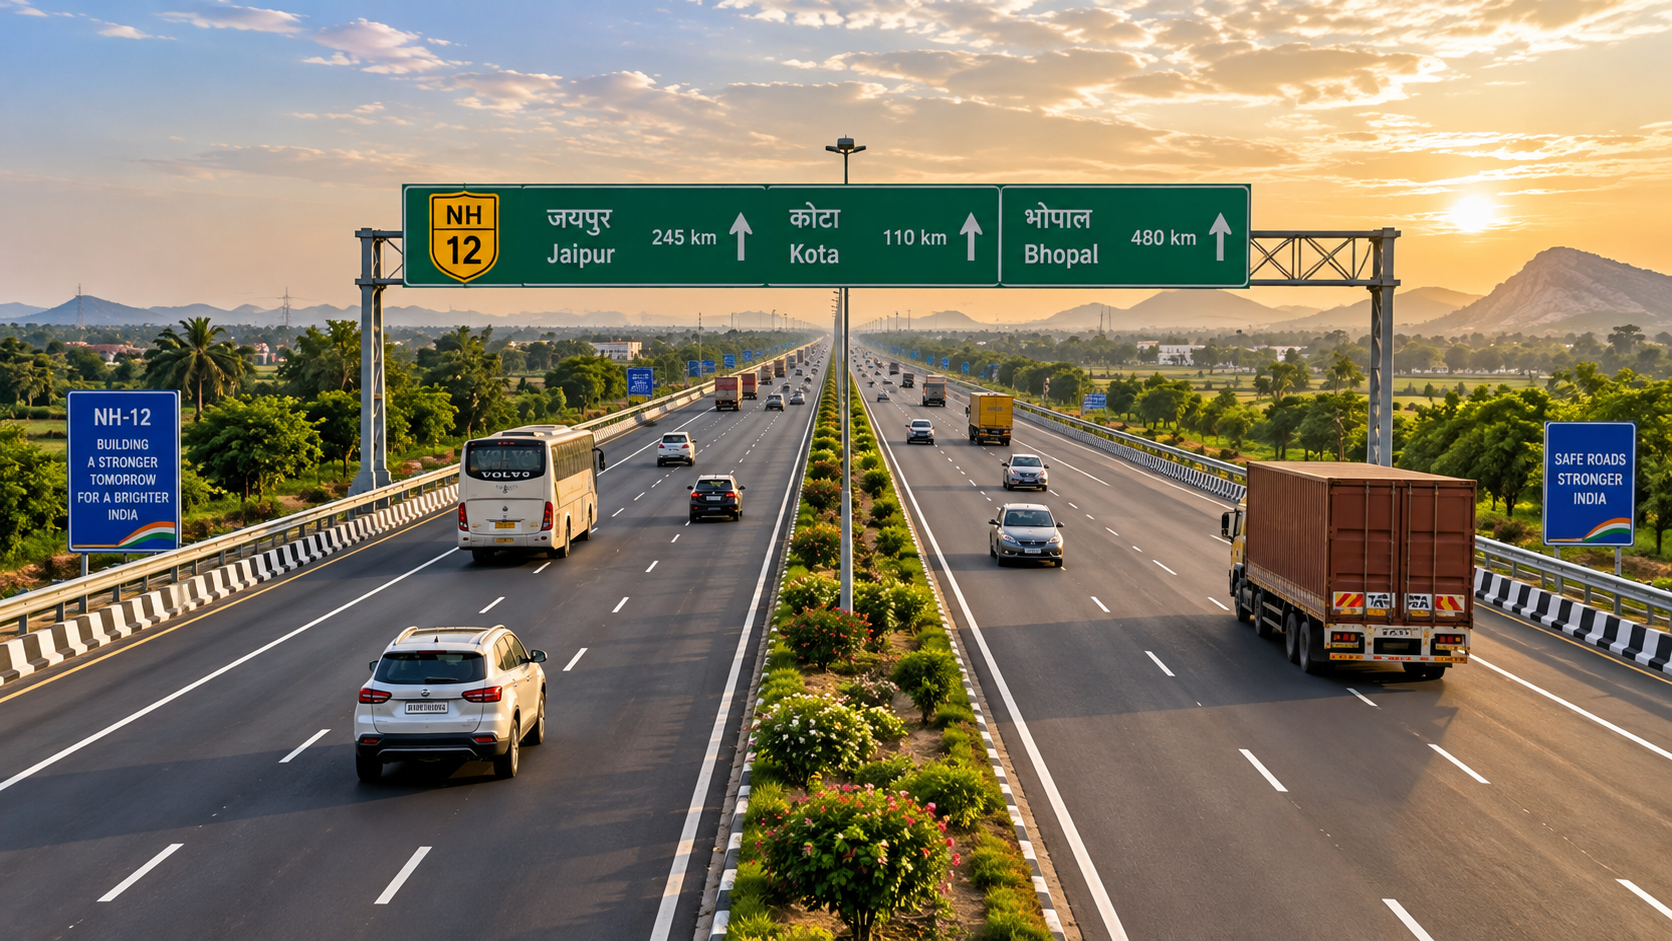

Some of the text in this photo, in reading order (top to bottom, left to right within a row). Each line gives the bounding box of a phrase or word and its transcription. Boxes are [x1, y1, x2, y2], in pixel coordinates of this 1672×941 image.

[446, 205, 482, 225] NH
[547, 208, 613, 235] जयपुर
[789, 202, 841, 229] कोटा
[1024, 202, 1093, 229] भोपाल
[652, 229, 717, 246] 245 km
[883, 229, 947, 246] 110 km
[1131, 229, 1197, 246] 480 km
[447, 235, 482, 265] 12
[547, 243, 616, 268] Jaipur
[789, 243, 840, 264] Kota
[1024, 243, 1099, 269] Bhopal
[94, 407, 151, 426] NH-12
[97, 438, 149, 450] BUILDING
[87, 456, 158, 468] A STRONGER
[1555, 453, 1627, 466] SAFE ROADS
[90, 473, 156, 485] TOMORROW
[481, 471, 530, 479] VOLVO
[1557, 472, 1623, 486] STRONGER
[77, 492, 169, 504] FOR A BRIGHTER
[1573, 492, 1607, 505] INDIA
[108, 509, 139, 521] INDIA
